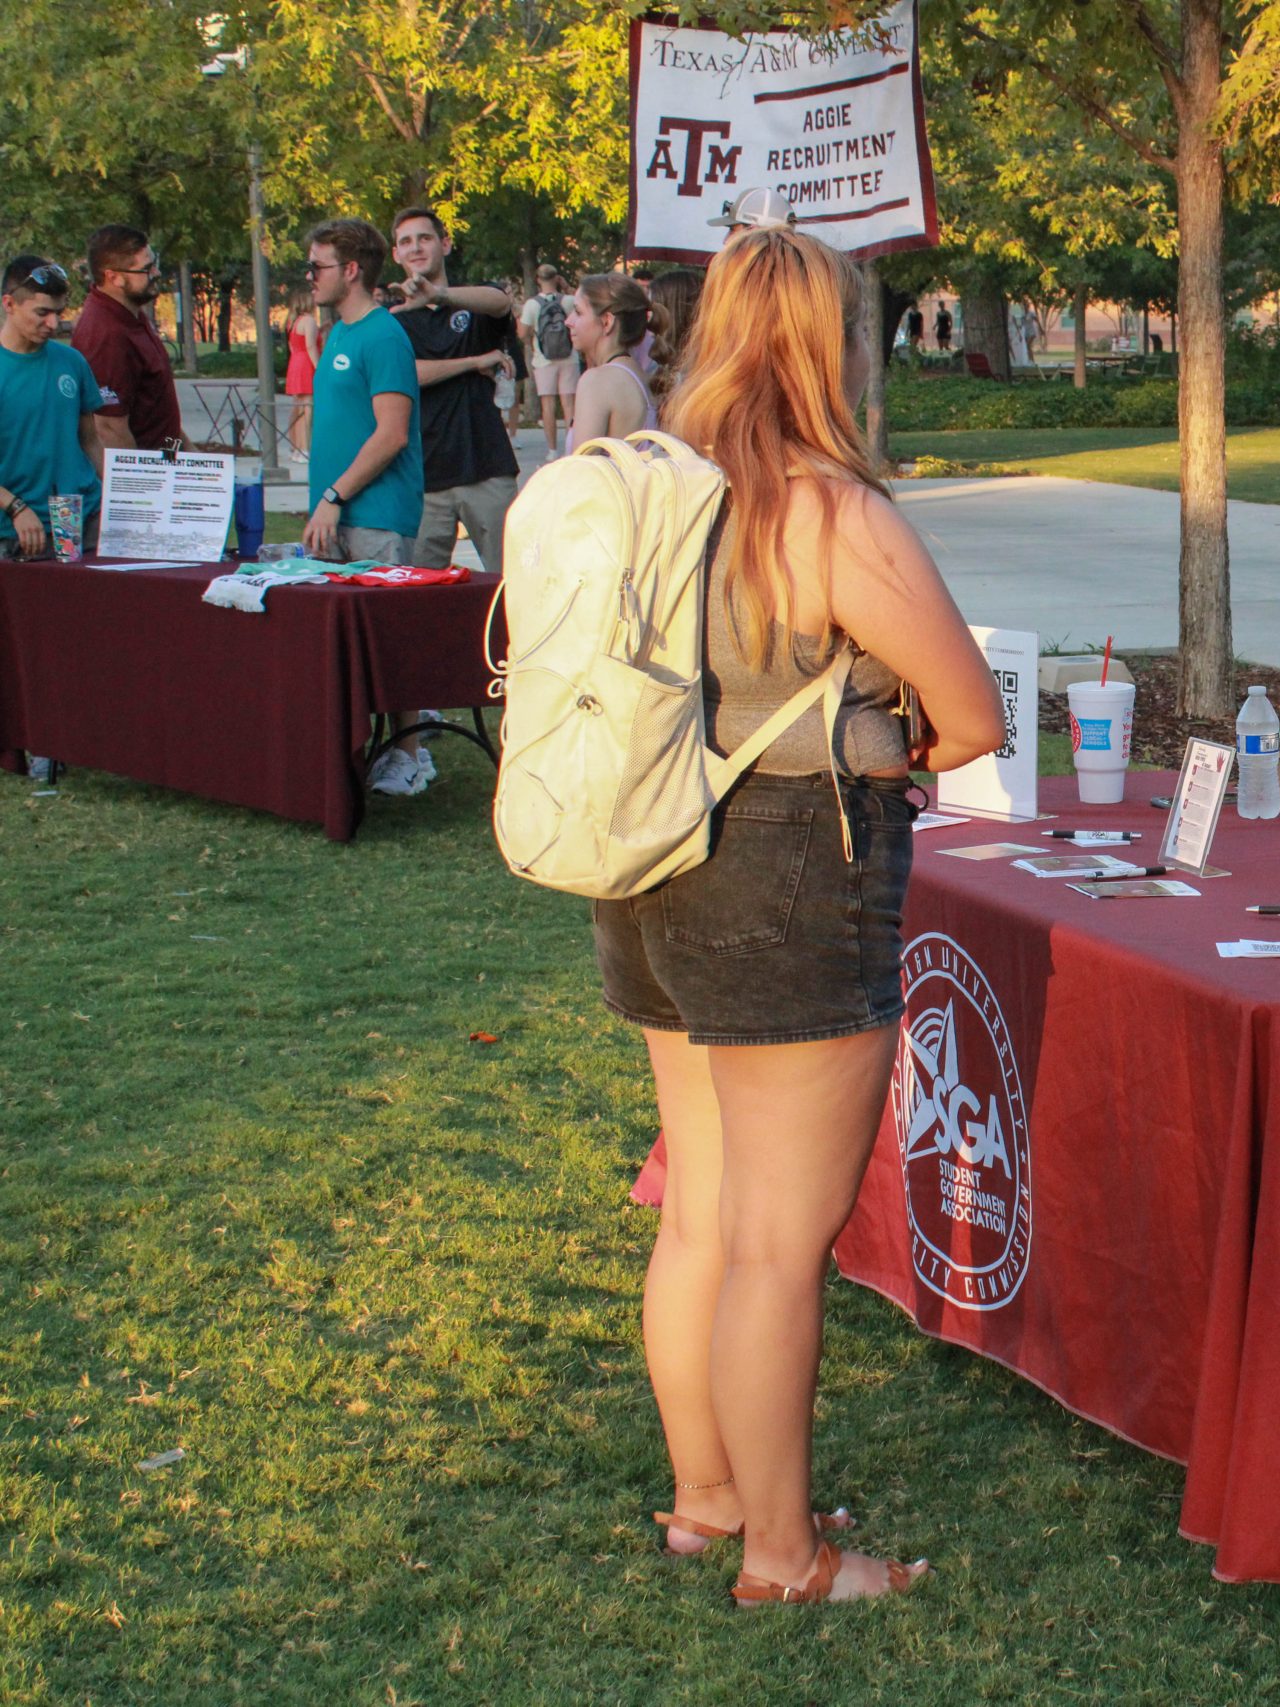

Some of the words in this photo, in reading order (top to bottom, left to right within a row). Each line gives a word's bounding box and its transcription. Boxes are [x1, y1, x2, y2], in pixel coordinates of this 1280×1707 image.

[654, 39, 733, 73] TEXAS
[750, 42, 798, 74] A&M
[808, 23, 904, 66] UNIVERSIT
[803, 103, 851, 132] AGGIE
[767, 130, 896, 171] RECRUITMENT
[115, 455, 137, 464] AGGIE
[186, 459, 224, 469] COMMITTEE
[942, 948, 1024, 1130] UNIVERSITY
[932, 1075, 1012, 1180] SGA
[939, 1158, 981, 1189] STUDENT
[940, 1178, 1006, 1218] GOVERNMENT
[941, 1197, 1006, 1236] ASSOCIATION
[964, 1182, 1029, 1299] COMMISSION
